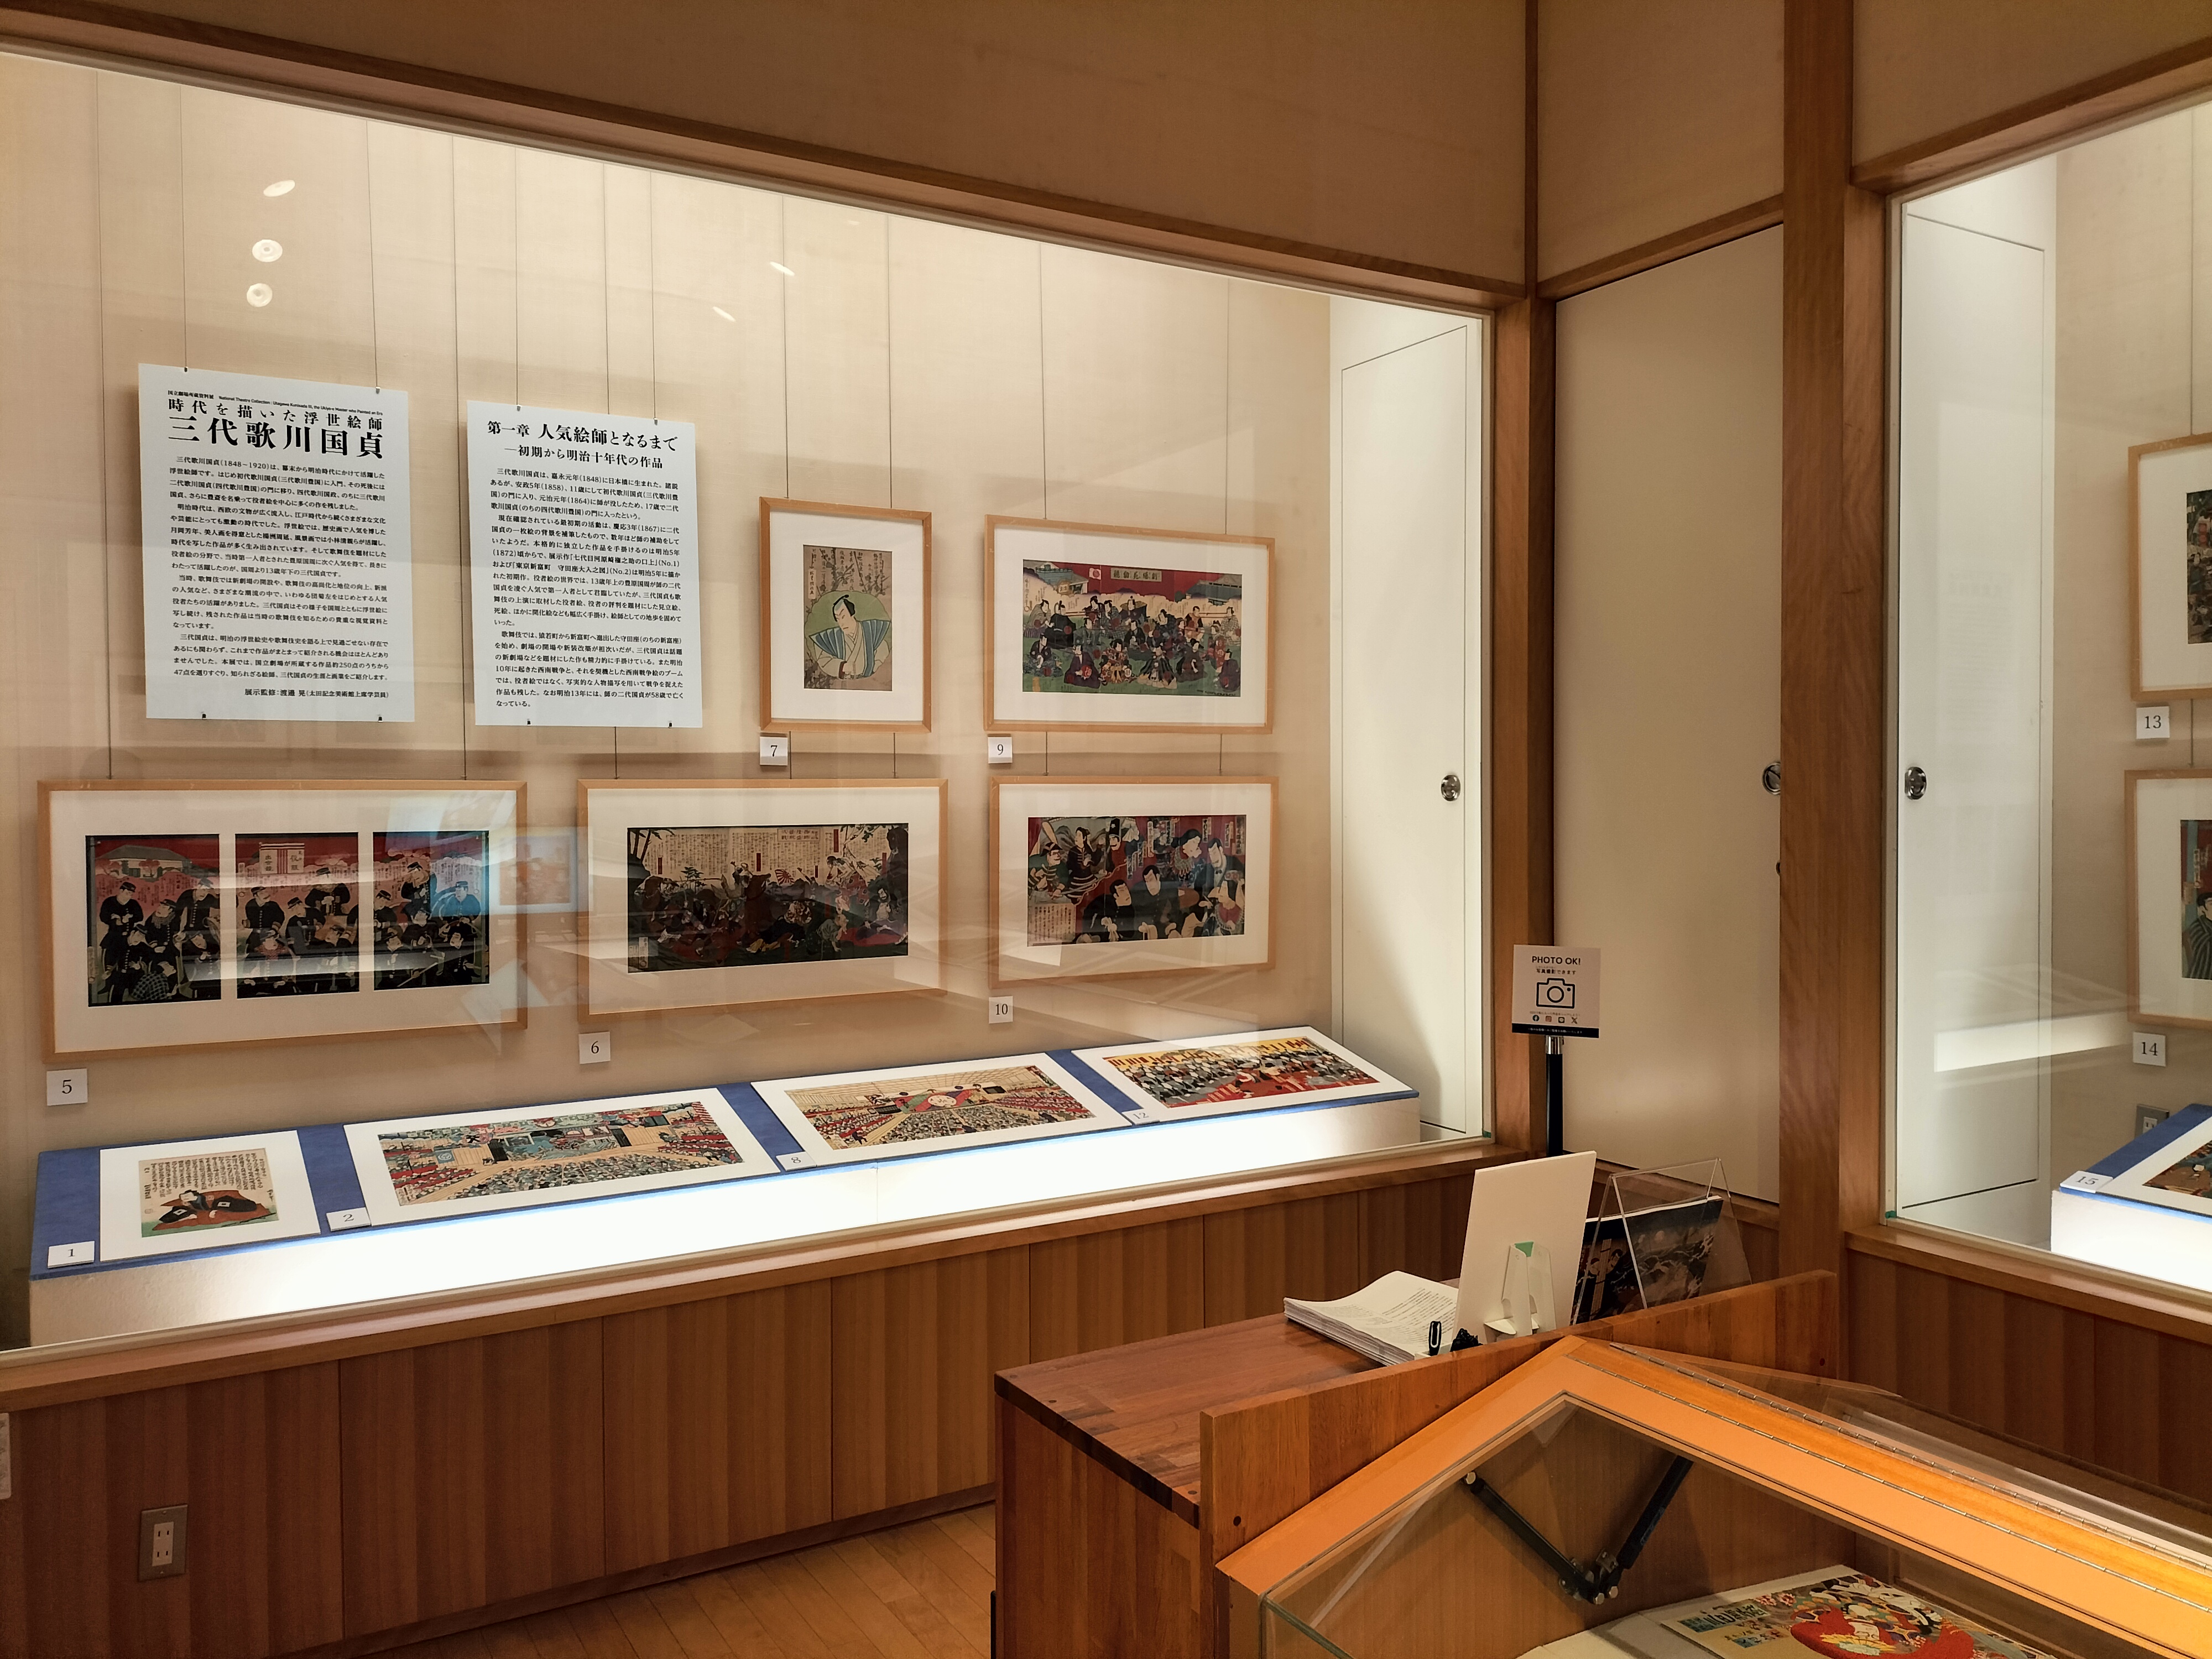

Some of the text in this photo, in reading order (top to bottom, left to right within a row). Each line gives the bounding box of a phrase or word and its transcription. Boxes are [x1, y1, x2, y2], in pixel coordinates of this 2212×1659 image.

[168, 398, 383, 431] 時代を描いた浮世絵師
[168, 412, 383, 459] 三代歌川国貞
[487, 420, 678, 452] 第一章 人気絵師となるまで
[173, 622, 214, 630] なっています。
[496, 698, 531, 707] なっている。
[2145, 716, 2161, 728] 13
[771, 745, 777, 757] 7
[998, 744, 1003, 754] 9
[1532, 956, 1563, 964] PHOTO
[996, 1004, 1008, 1015] 10
[591, 1041, 599, 1054] 6
[2142, 1042, 2157, 1056] 14
[62, 1079, 72, 1094] 5
[69, 1249, 74, 1257] 1
